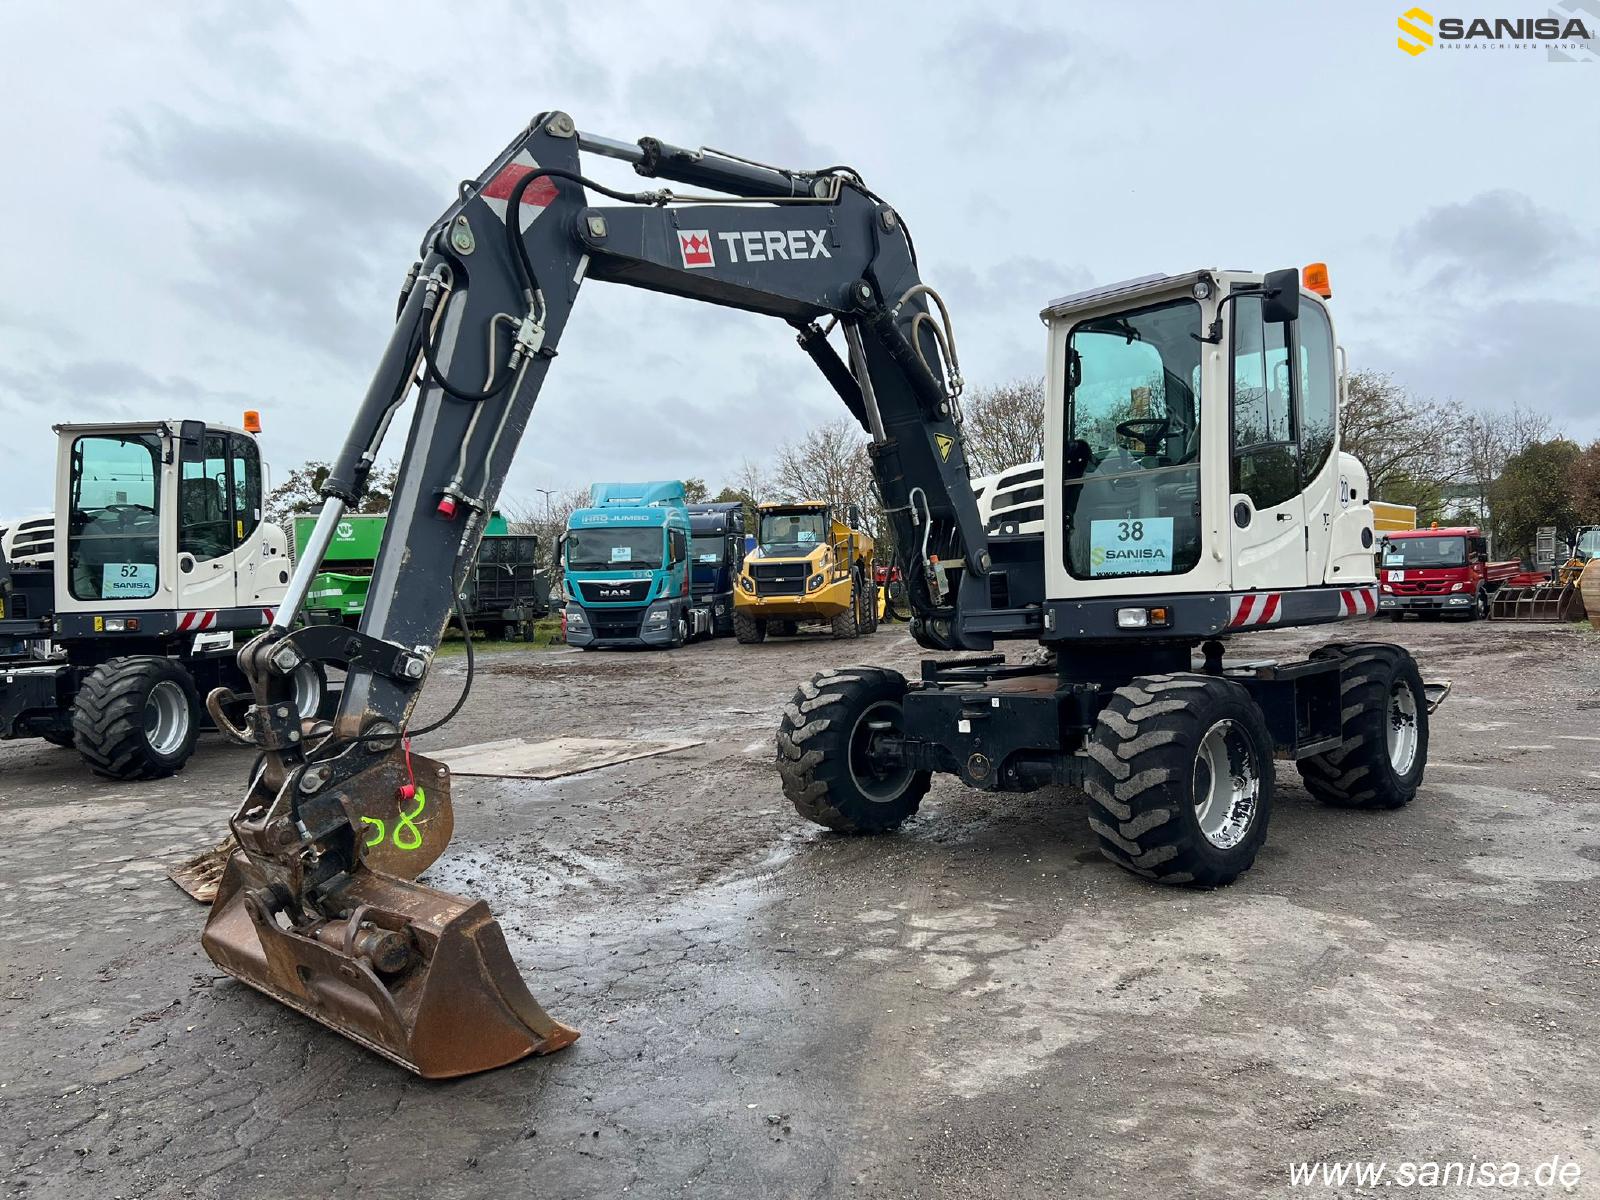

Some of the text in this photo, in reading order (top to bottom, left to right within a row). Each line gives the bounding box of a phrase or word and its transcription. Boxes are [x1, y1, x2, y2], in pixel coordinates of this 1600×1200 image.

[718, 229, 832, 263] TEREX
[1117, 521, 1144, 541] 38
[1105, 548, 1165, 559] SANISA
[120, 565, 138, 577] 52
